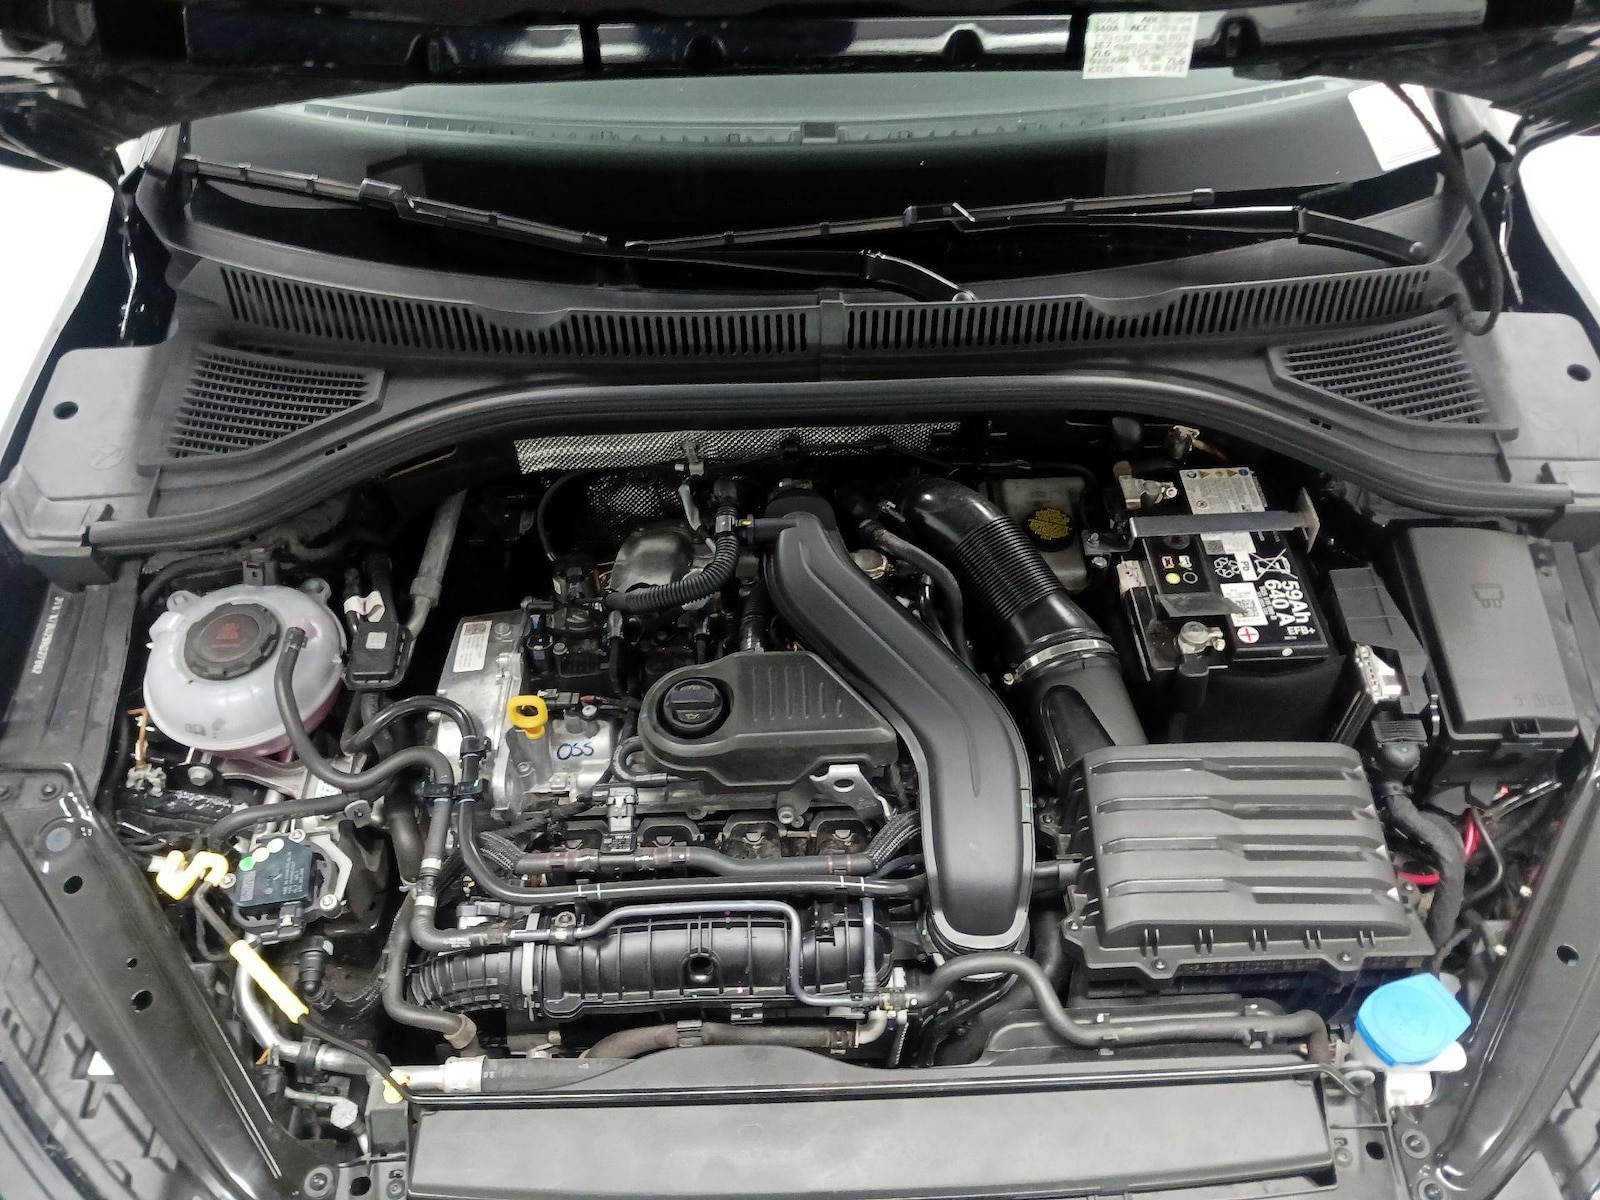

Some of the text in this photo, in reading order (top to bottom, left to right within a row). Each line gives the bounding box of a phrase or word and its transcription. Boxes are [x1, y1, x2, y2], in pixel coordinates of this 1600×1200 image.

[1264, 579, 1290, 610] 640
[1282, 580, 1312, 624] 59Ah
[1275, 612, 1296, 627] A
[1286, 625, 1316, 636] EFB+
